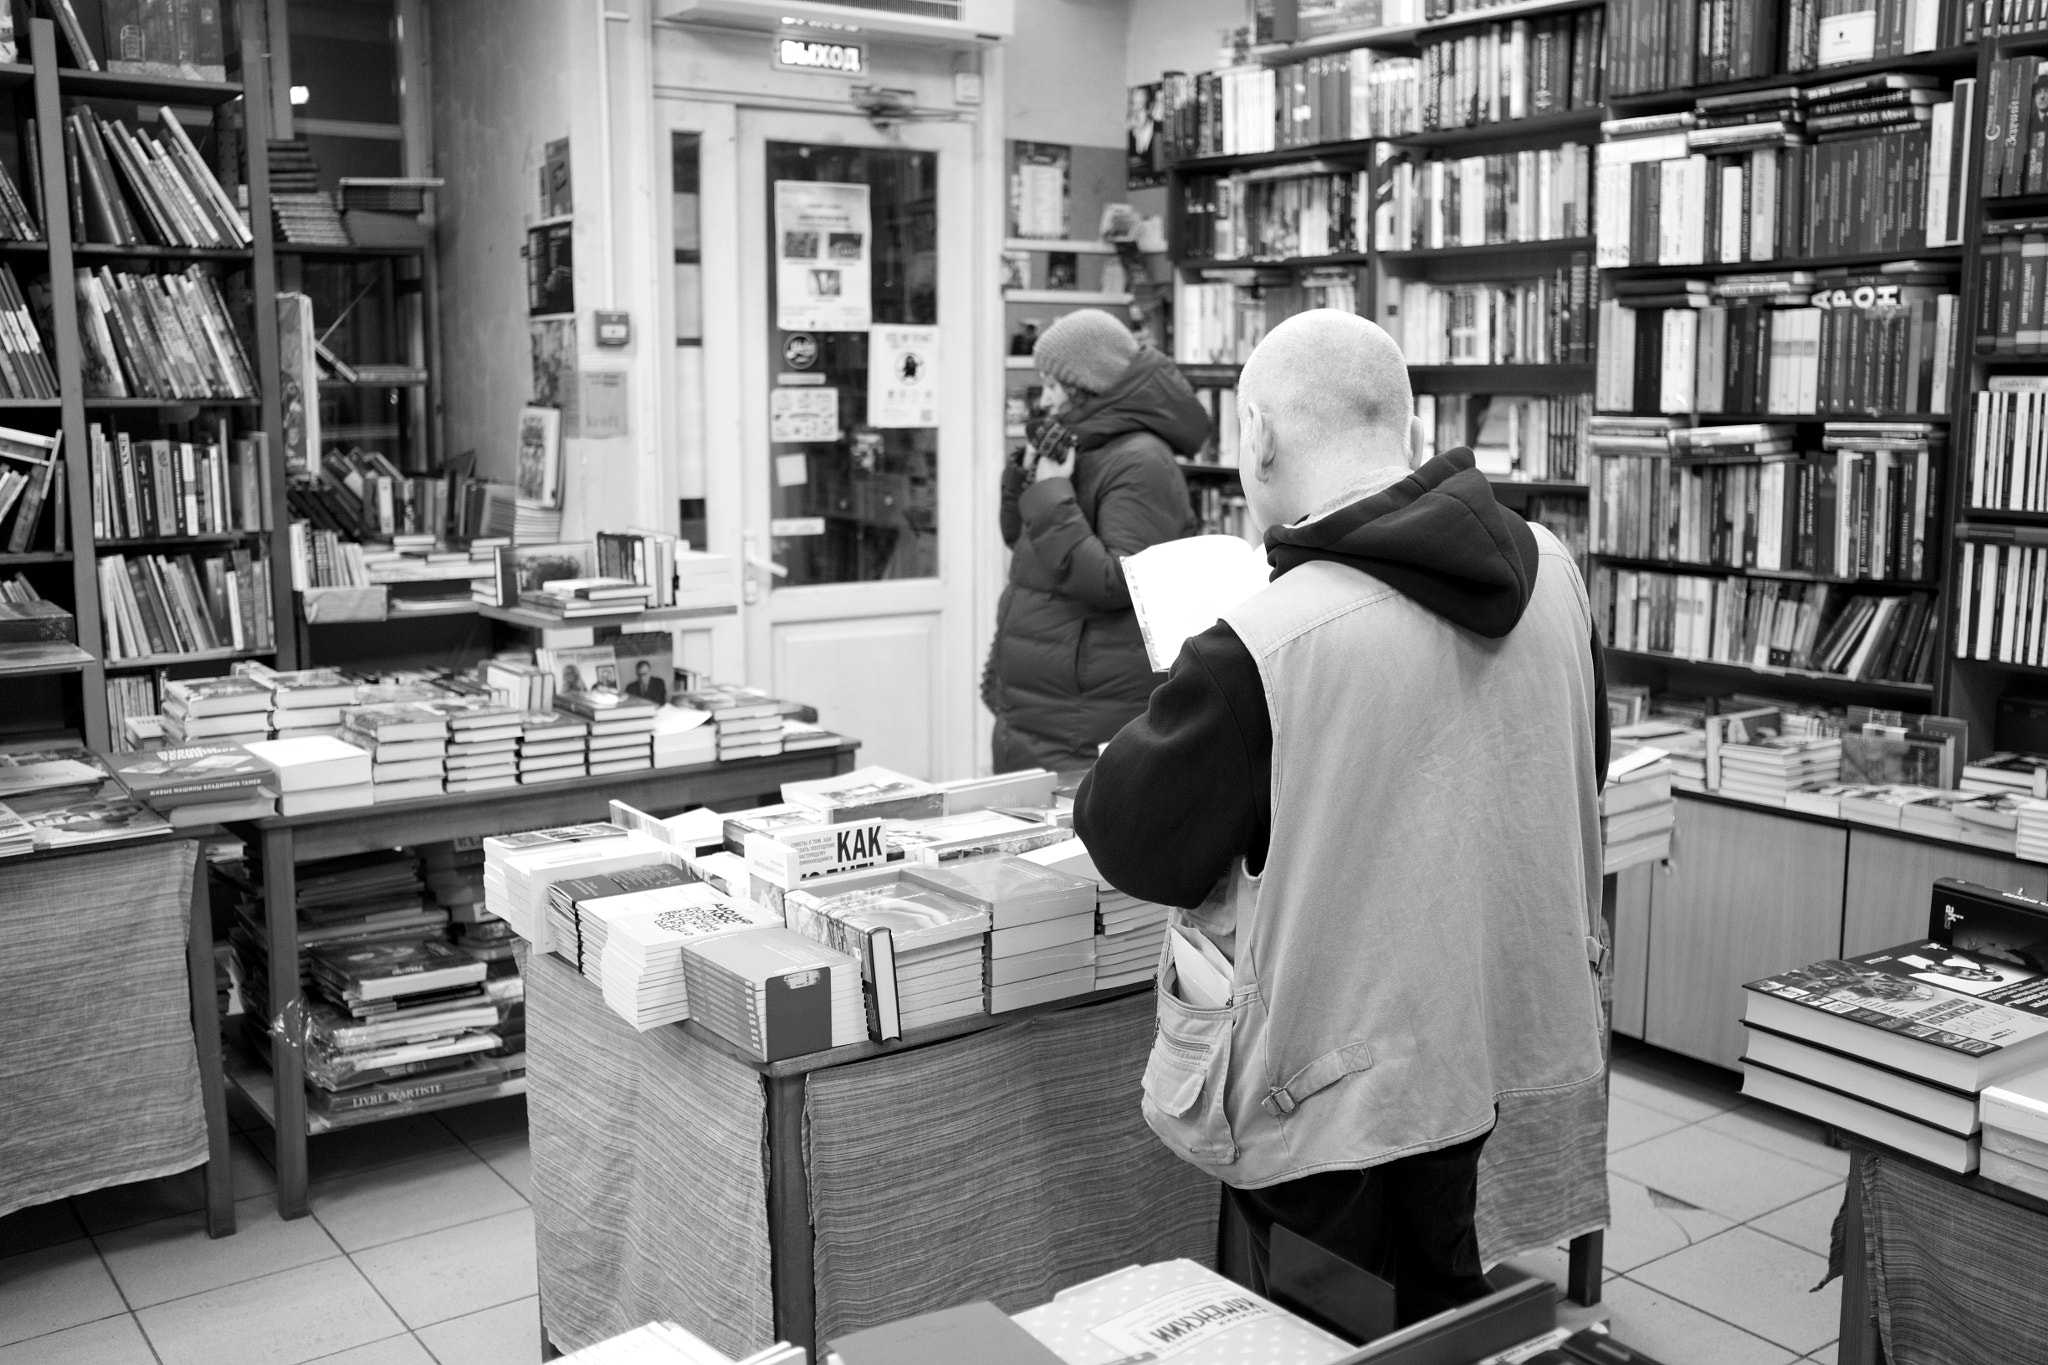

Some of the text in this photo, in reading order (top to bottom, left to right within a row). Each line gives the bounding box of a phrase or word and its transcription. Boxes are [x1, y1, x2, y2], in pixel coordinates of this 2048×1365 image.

[781, 40, 860, 72] ВЫХОД
[174, 785, 203, 794] МАШИНЫ
[203, 780, 241, 792] ВЛАДИМИРА
[837, 825, 882, 863] КАК
[706, 909, 736, 924] ЛООС
[712, 903, 754, 925] АДОЛЬФ
[352, 1093, 387, 1108] LIVRE
